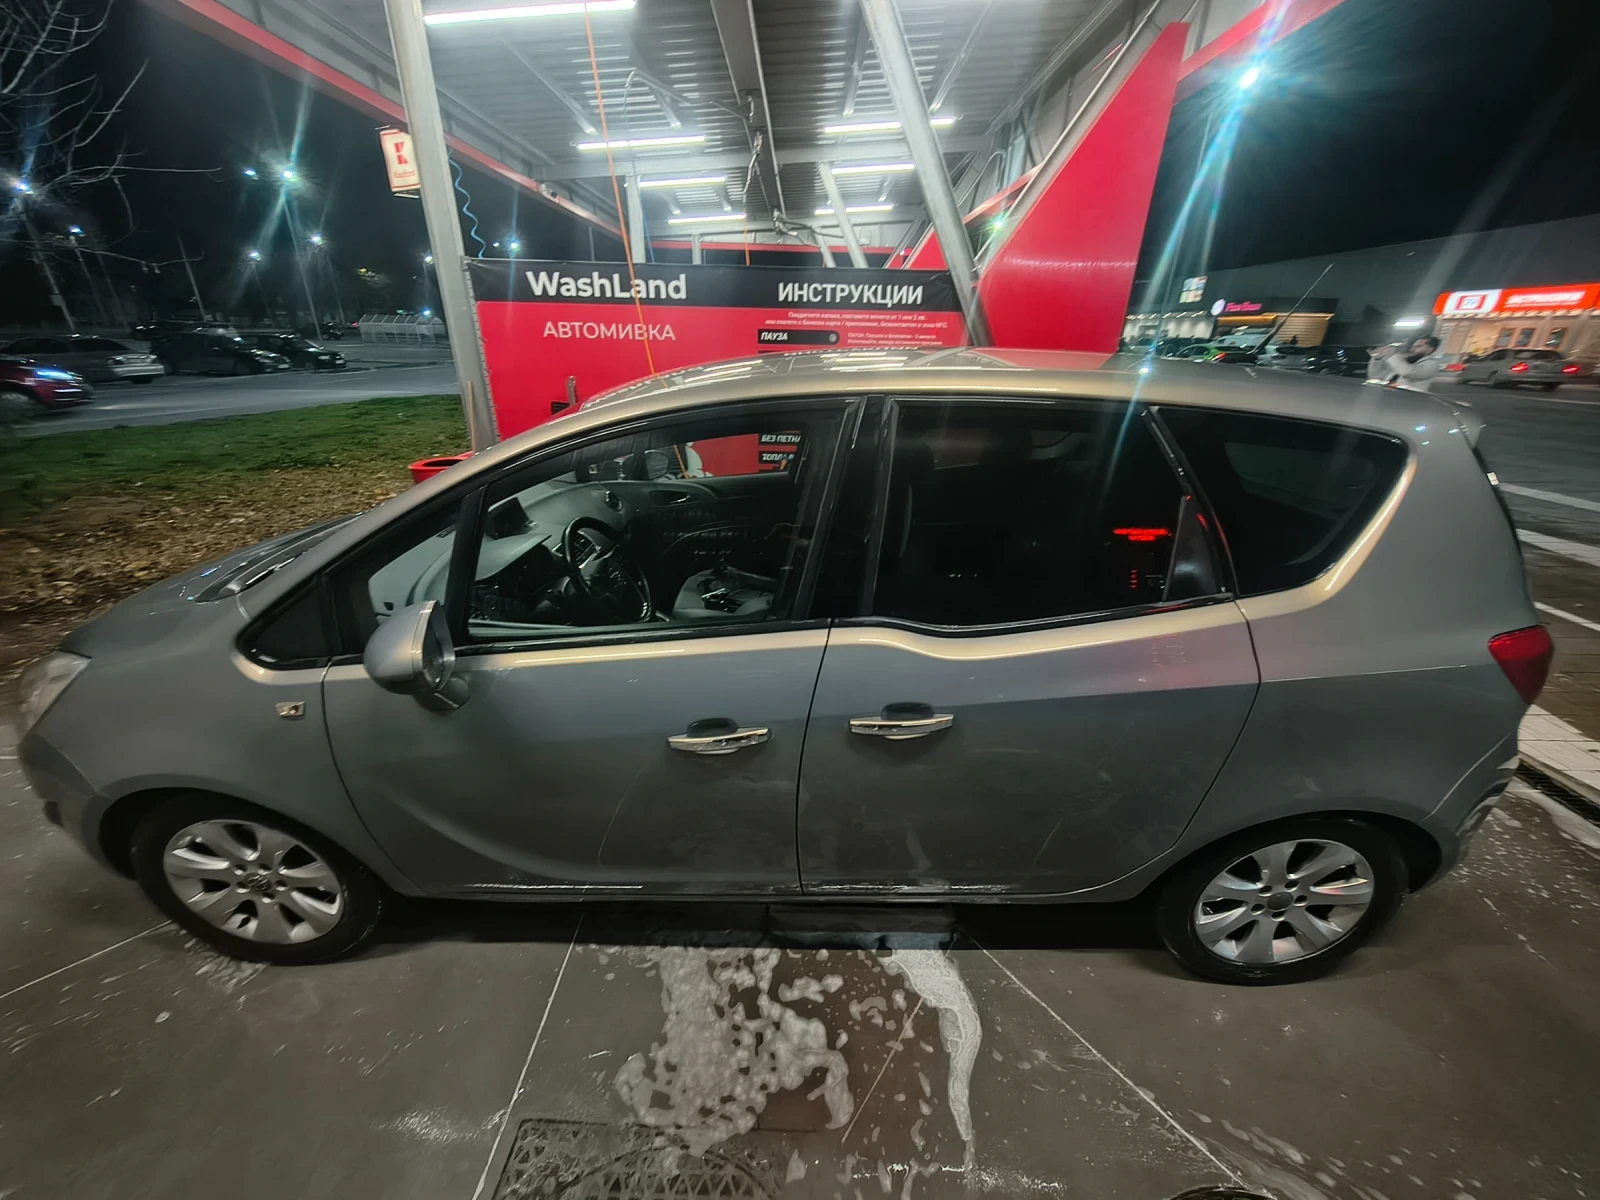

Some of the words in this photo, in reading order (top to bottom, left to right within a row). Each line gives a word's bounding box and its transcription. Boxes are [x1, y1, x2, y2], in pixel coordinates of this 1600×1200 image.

[525, 271, 687, 300] WashLand
[777, 282, 923, 308] ИНСТРУКЦИИ
[543, 321, 676, 341] АВТОМИВКА
[760, 331, 788, 341] ПАУЗА
[761, 434, 776, 442] БЕЗ
